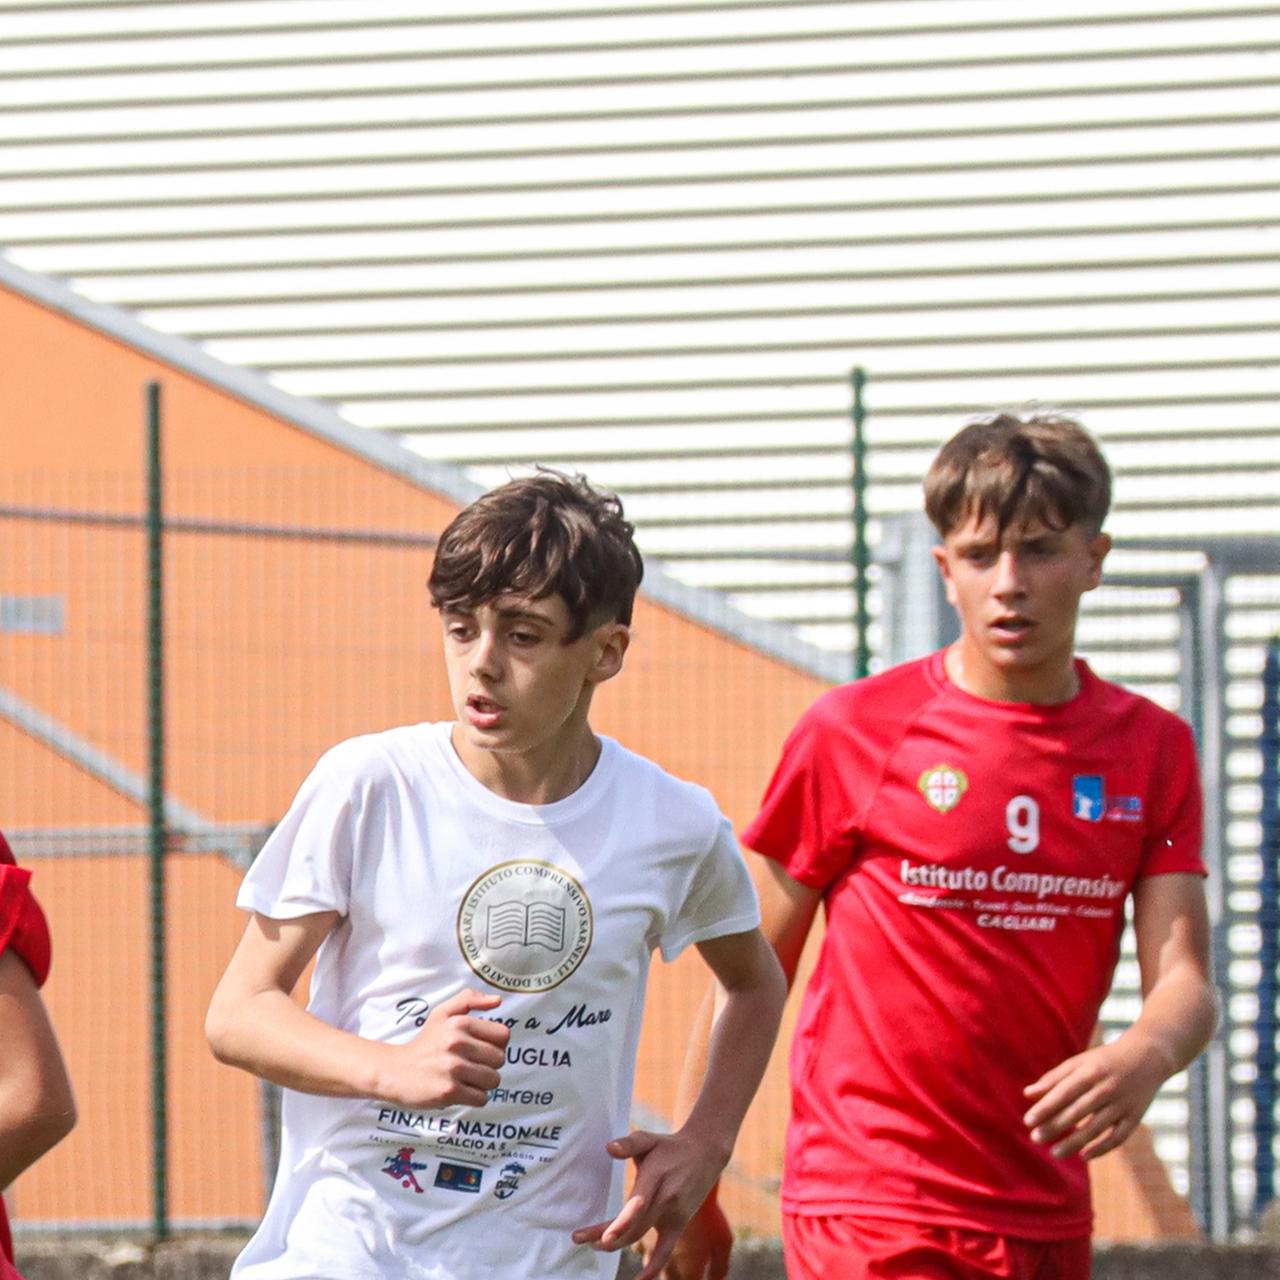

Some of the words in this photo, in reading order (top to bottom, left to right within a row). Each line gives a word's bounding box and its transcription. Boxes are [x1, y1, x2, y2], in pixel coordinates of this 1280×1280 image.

[1005, 795, 1040, 854] 9
[468, 867, 513, 911] ISTITUTO
[900, 859, 988, 891] Istituto
[524, 1015, 541, 1030] a
[546, 1003, 613, 1035] Mare
[506, 1047, 572, 1068] UGLIA
[377, 1108, 452, 1132] FINALE
[455, 1119, 562, 1141] NAZIONALE
[436, 1135, 485, 1150] CALCIO
[486, 1141, 497, 1151] A
